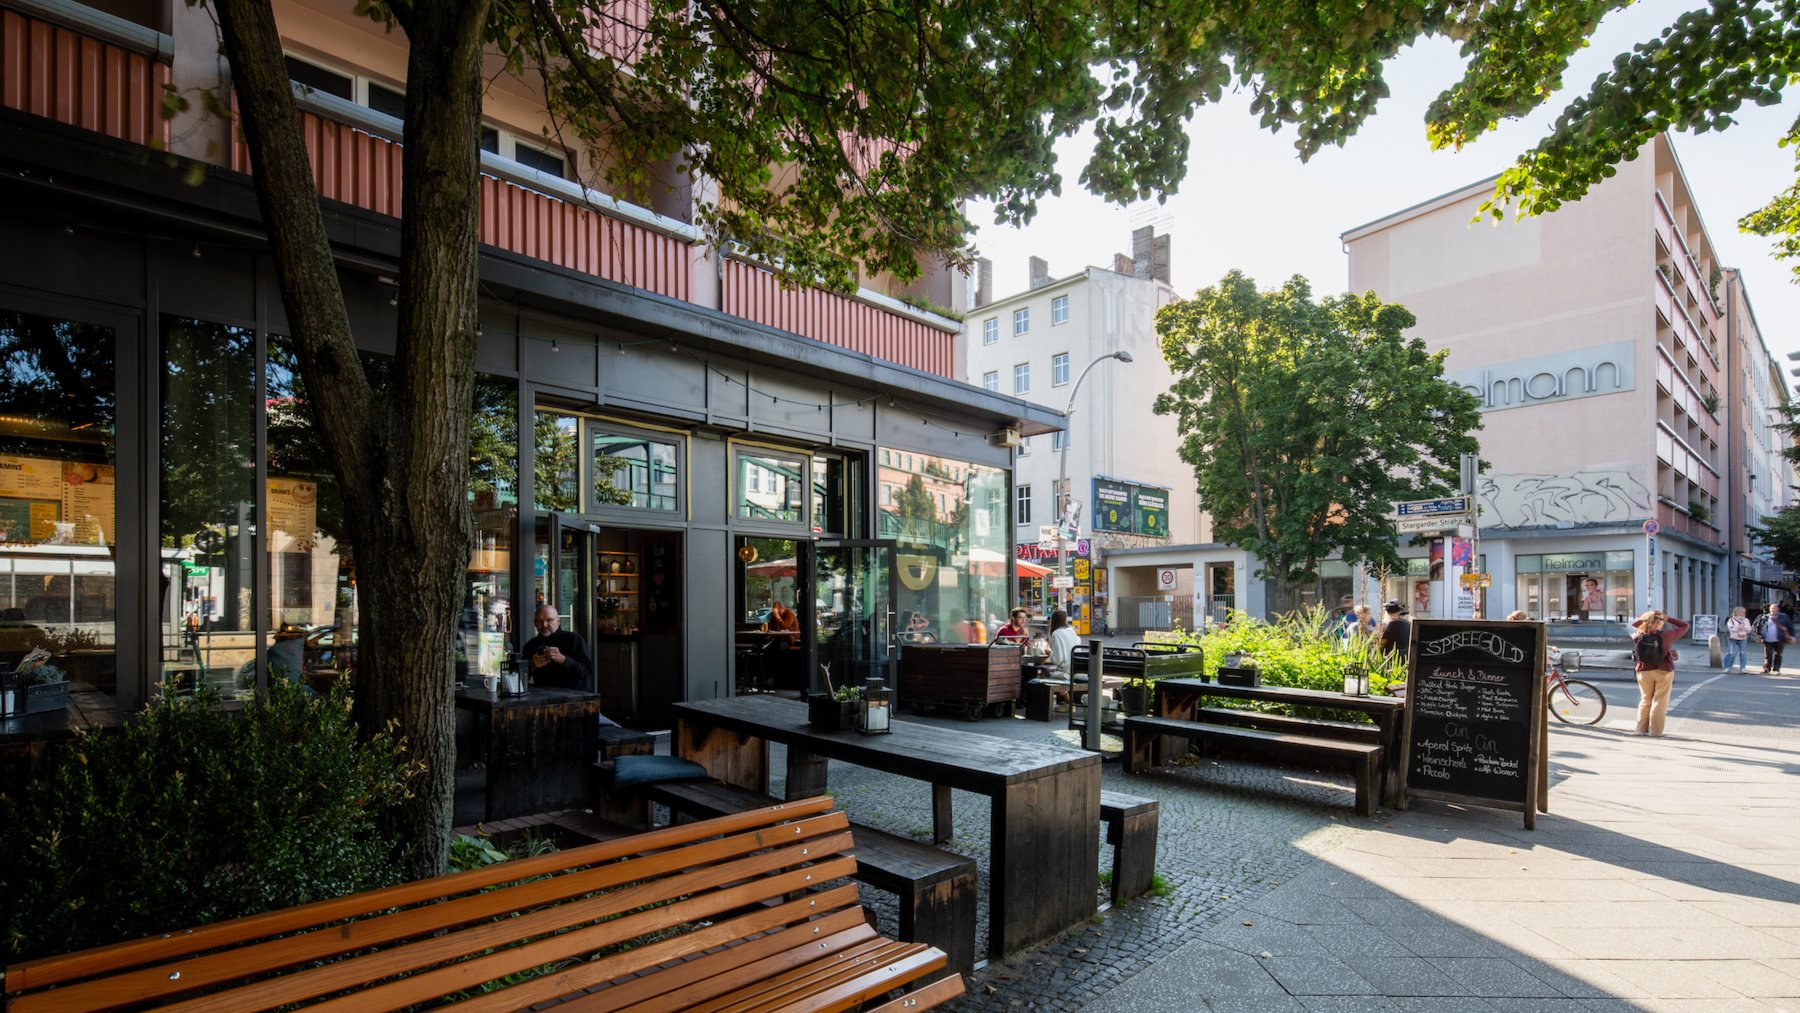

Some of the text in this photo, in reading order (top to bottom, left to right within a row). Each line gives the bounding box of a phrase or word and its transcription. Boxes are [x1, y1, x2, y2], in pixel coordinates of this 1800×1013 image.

[1402, 520, 1438, 530] Stargarder
[1426, 631, 1524, 663] SPREEGOLD
[1432, 667, 1505, 682] Lunch & Dinner
[1445, 722, 1470, 740] Cin
[1420, 739, 1473, 758] Aperol Spritz
[1475, 734, 1499, 754] Cin
[1423, 765, 1450, 780] Piccolo
